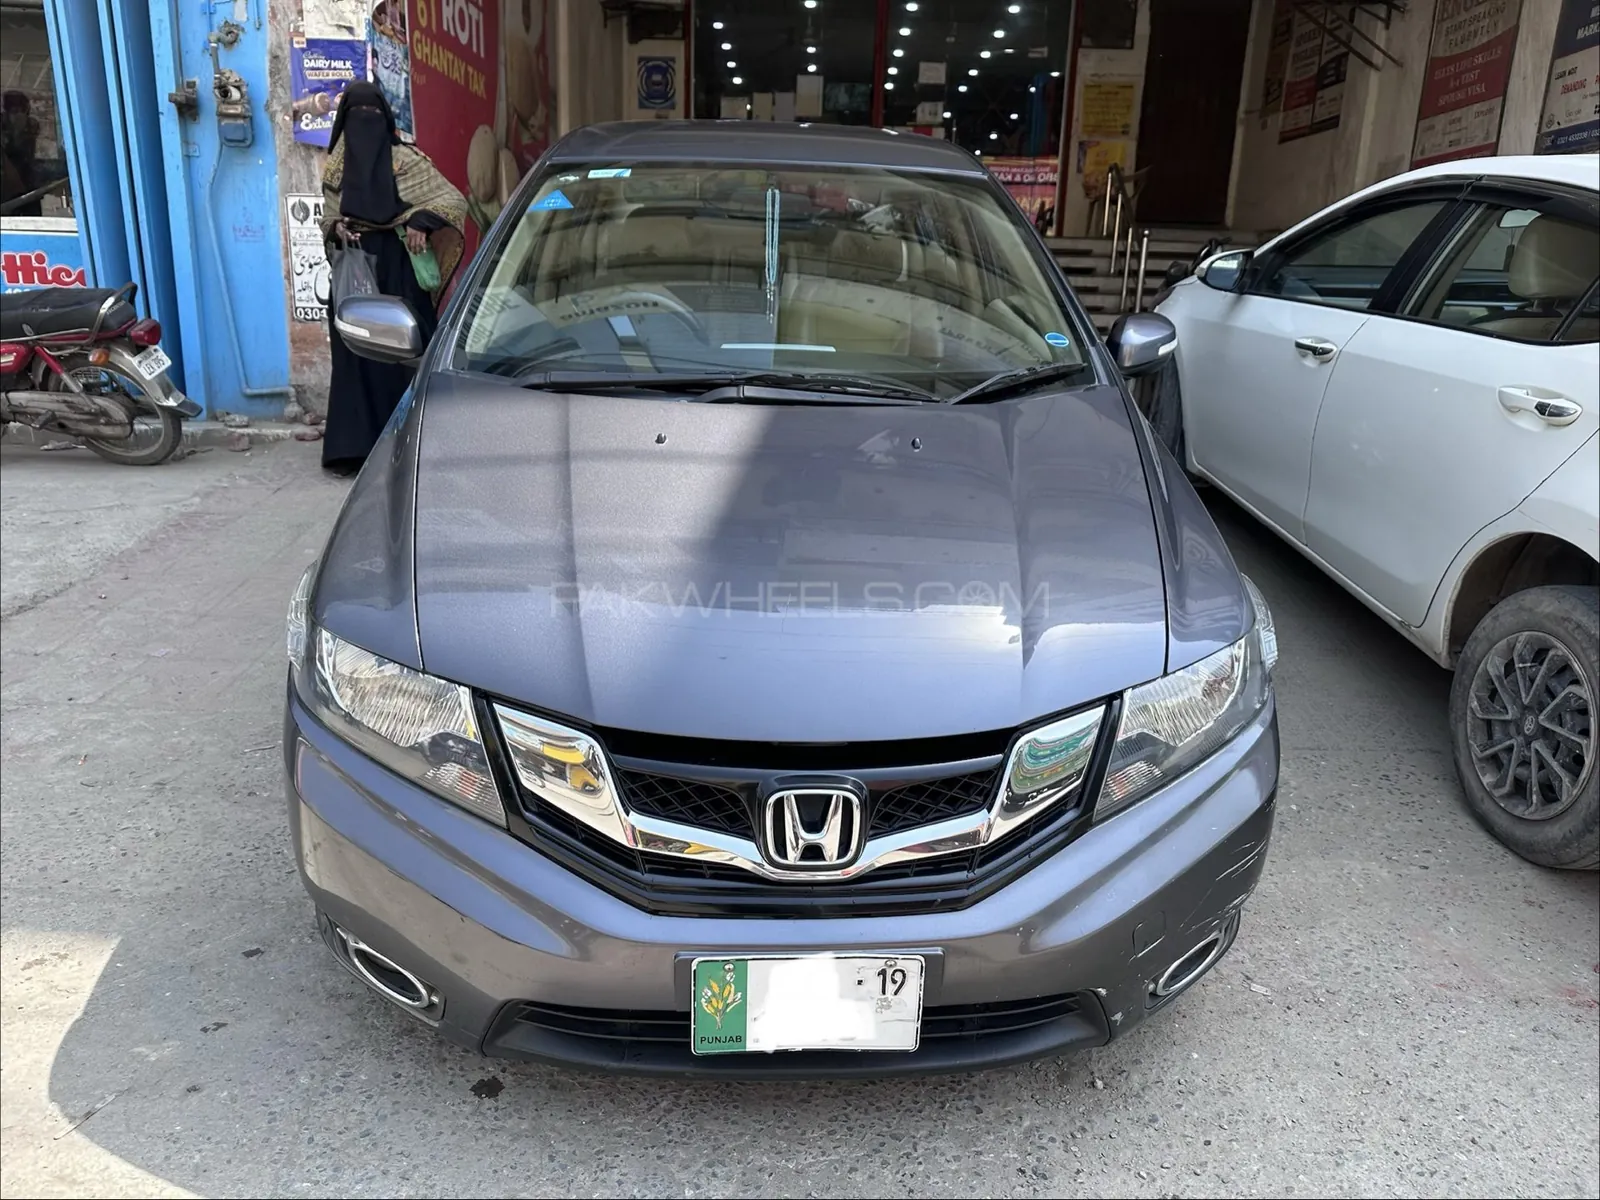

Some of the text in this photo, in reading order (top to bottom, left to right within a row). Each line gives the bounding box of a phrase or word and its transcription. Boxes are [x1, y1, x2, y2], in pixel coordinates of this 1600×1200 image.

[442, 0, 485, 58] ROTI
[303, 59, 352, 69] DAIRY MILK
[412, 30, 466, 86] GHANTAY
[467, 65, 487, 99] TAK
[300, 112, 332, 131] Extra
[876, 968, 907, 996] 19
[700, 1035, 742, 1045] PUNJAB
